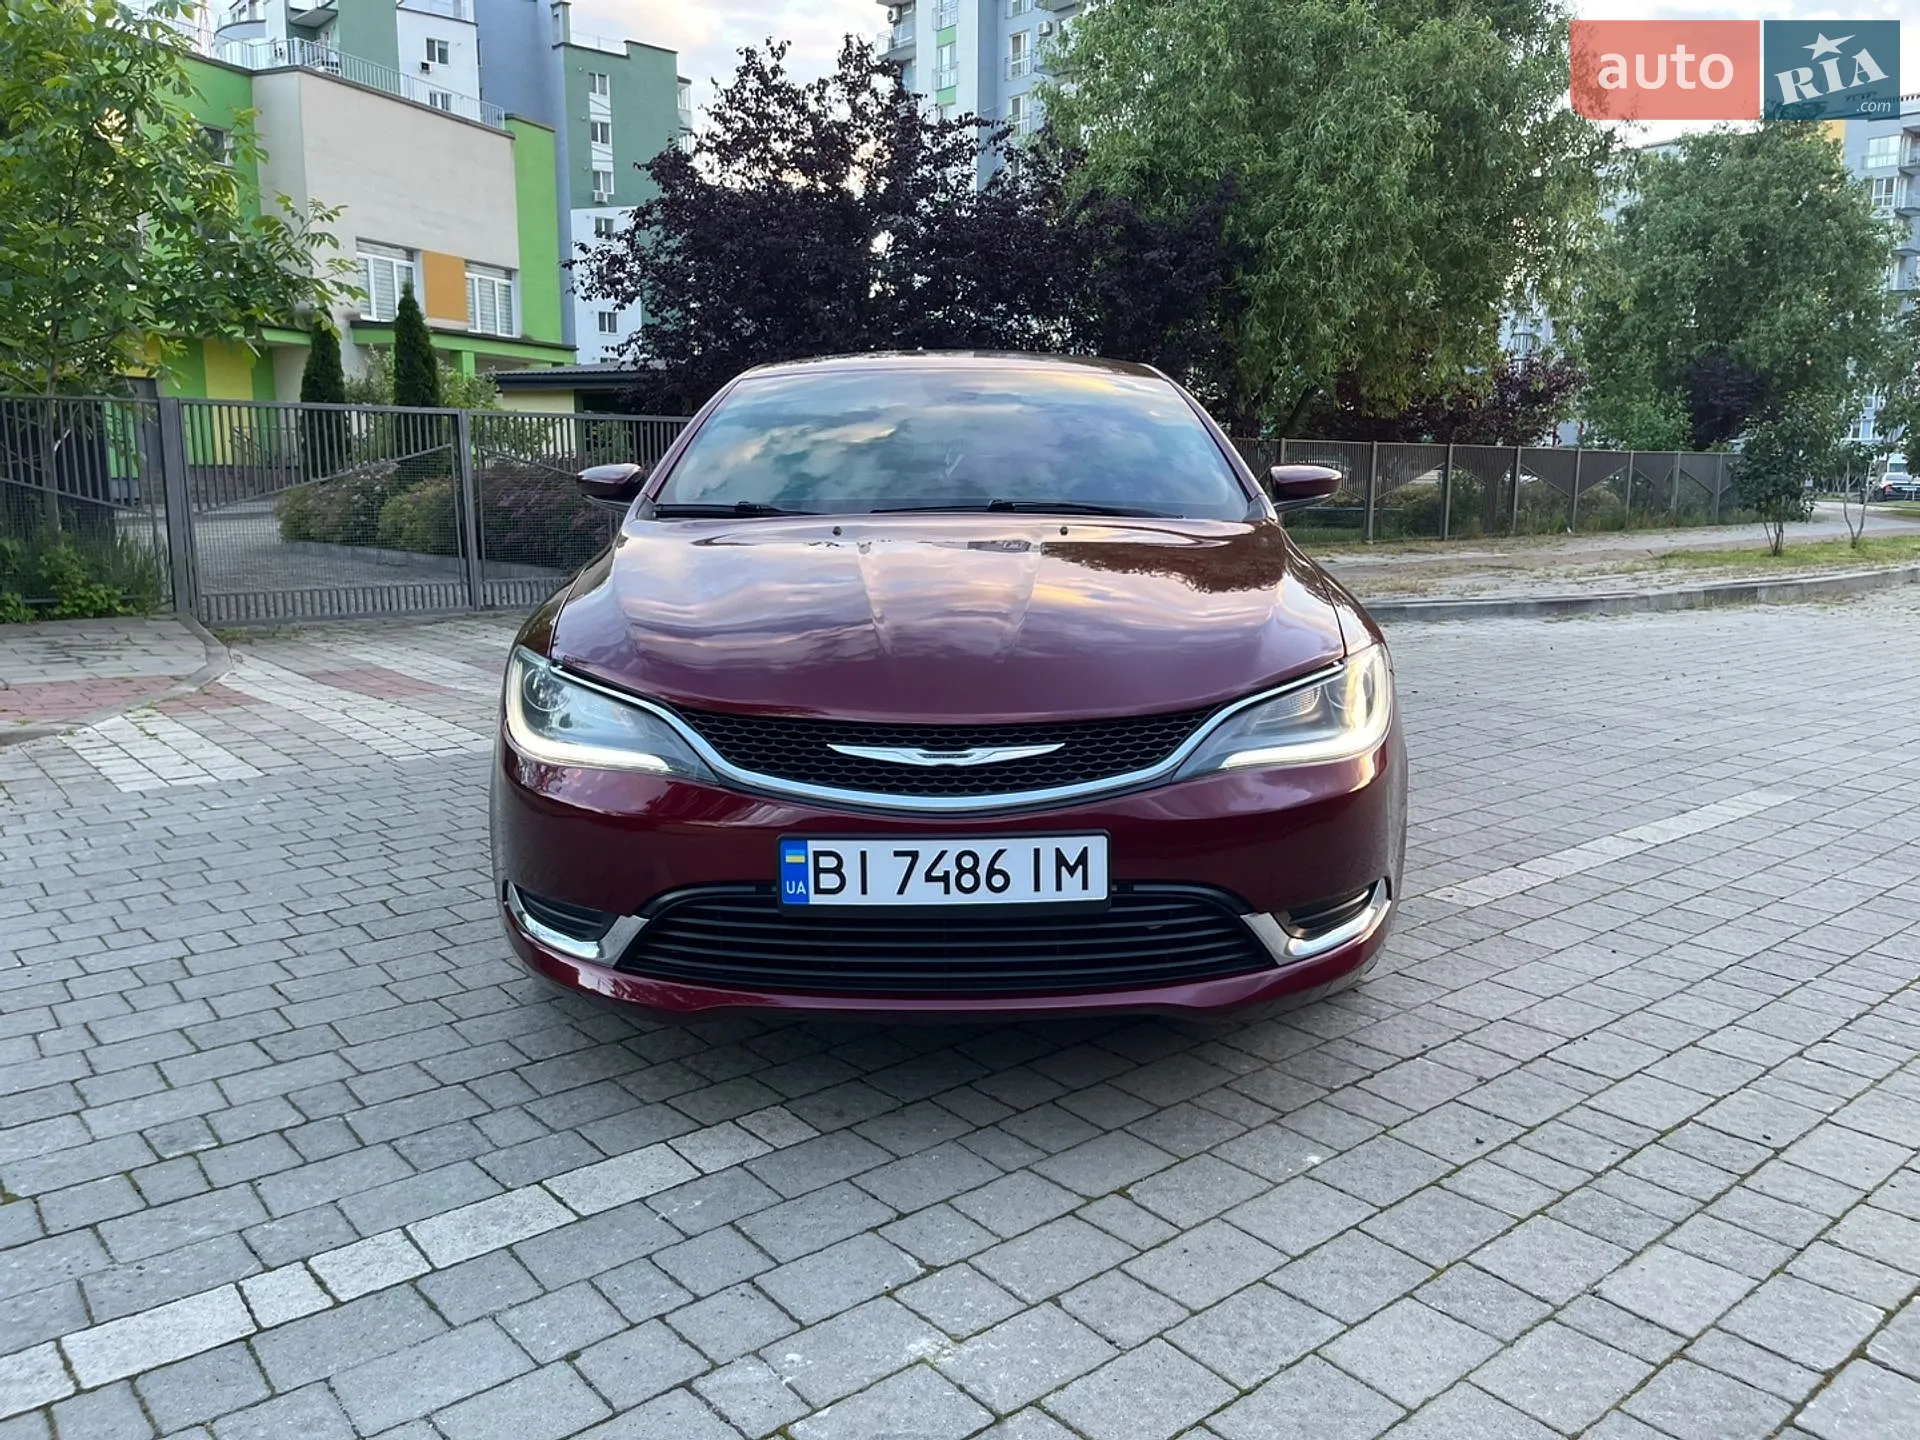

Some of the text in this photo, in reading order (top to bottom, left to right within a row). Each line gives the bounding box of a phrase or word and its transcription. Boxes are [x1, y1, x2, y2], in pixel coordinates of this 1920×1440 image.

[812, 846, 1089, 896] BI 7486 IM
[785, 880, 807, 895] UA
